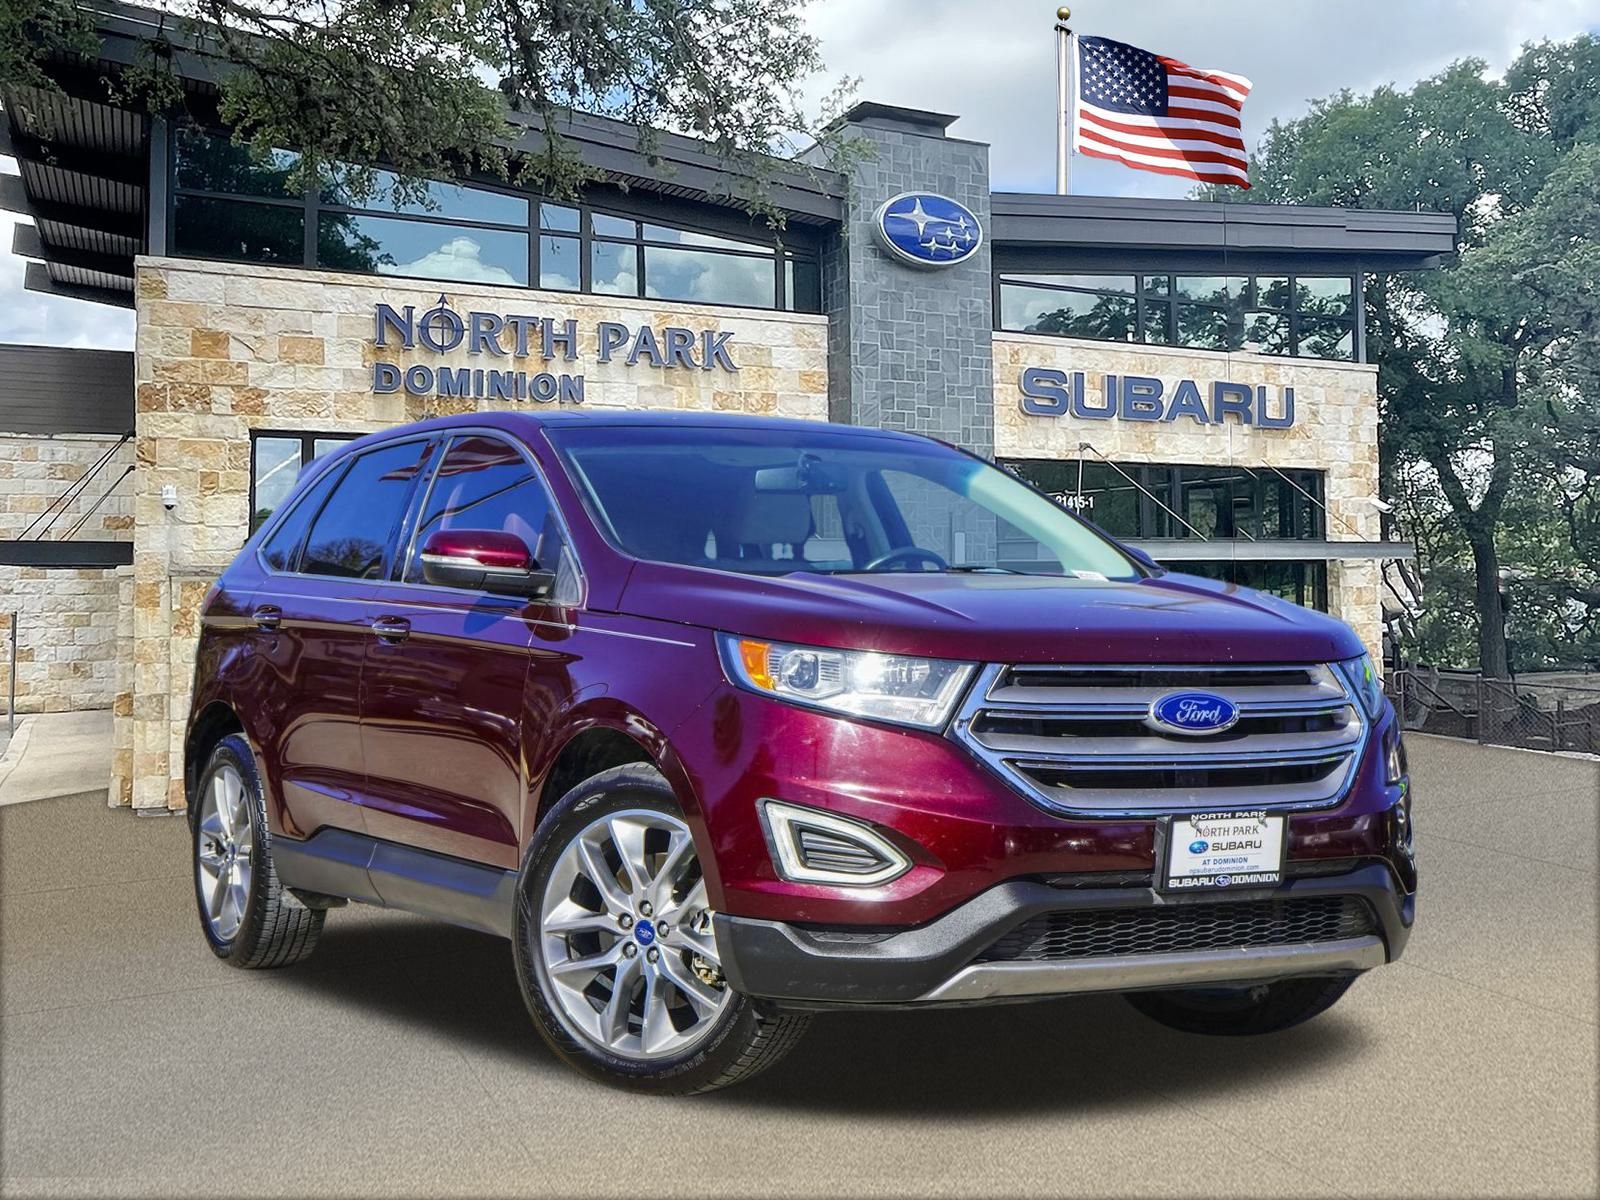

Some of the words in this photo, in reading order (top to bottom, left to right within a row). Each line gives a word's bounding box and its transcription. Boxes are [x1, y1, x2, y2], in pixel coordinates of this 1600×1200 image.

[375, 293, 579, 361] NORTH
[597, 321, 741, 373] PARK
[373, 362, 585, 404] DOMINION
[1019, 367, 1295, 430] SUBARU
[1176, 699, 1222, 724] Ford
[1191, 812, 1232, 820] NORTH
[1195, 825, 1230, 838] NORTH
[1232, 825, 1260, 836] PARK
[1211, 840, 1262, 851] SUBARU
[1213, 857, 1248, 865] DOMINION
[1168, 876, 1215, 888] SUBARU
[1231, 873, 1280, 884] DOMINION
